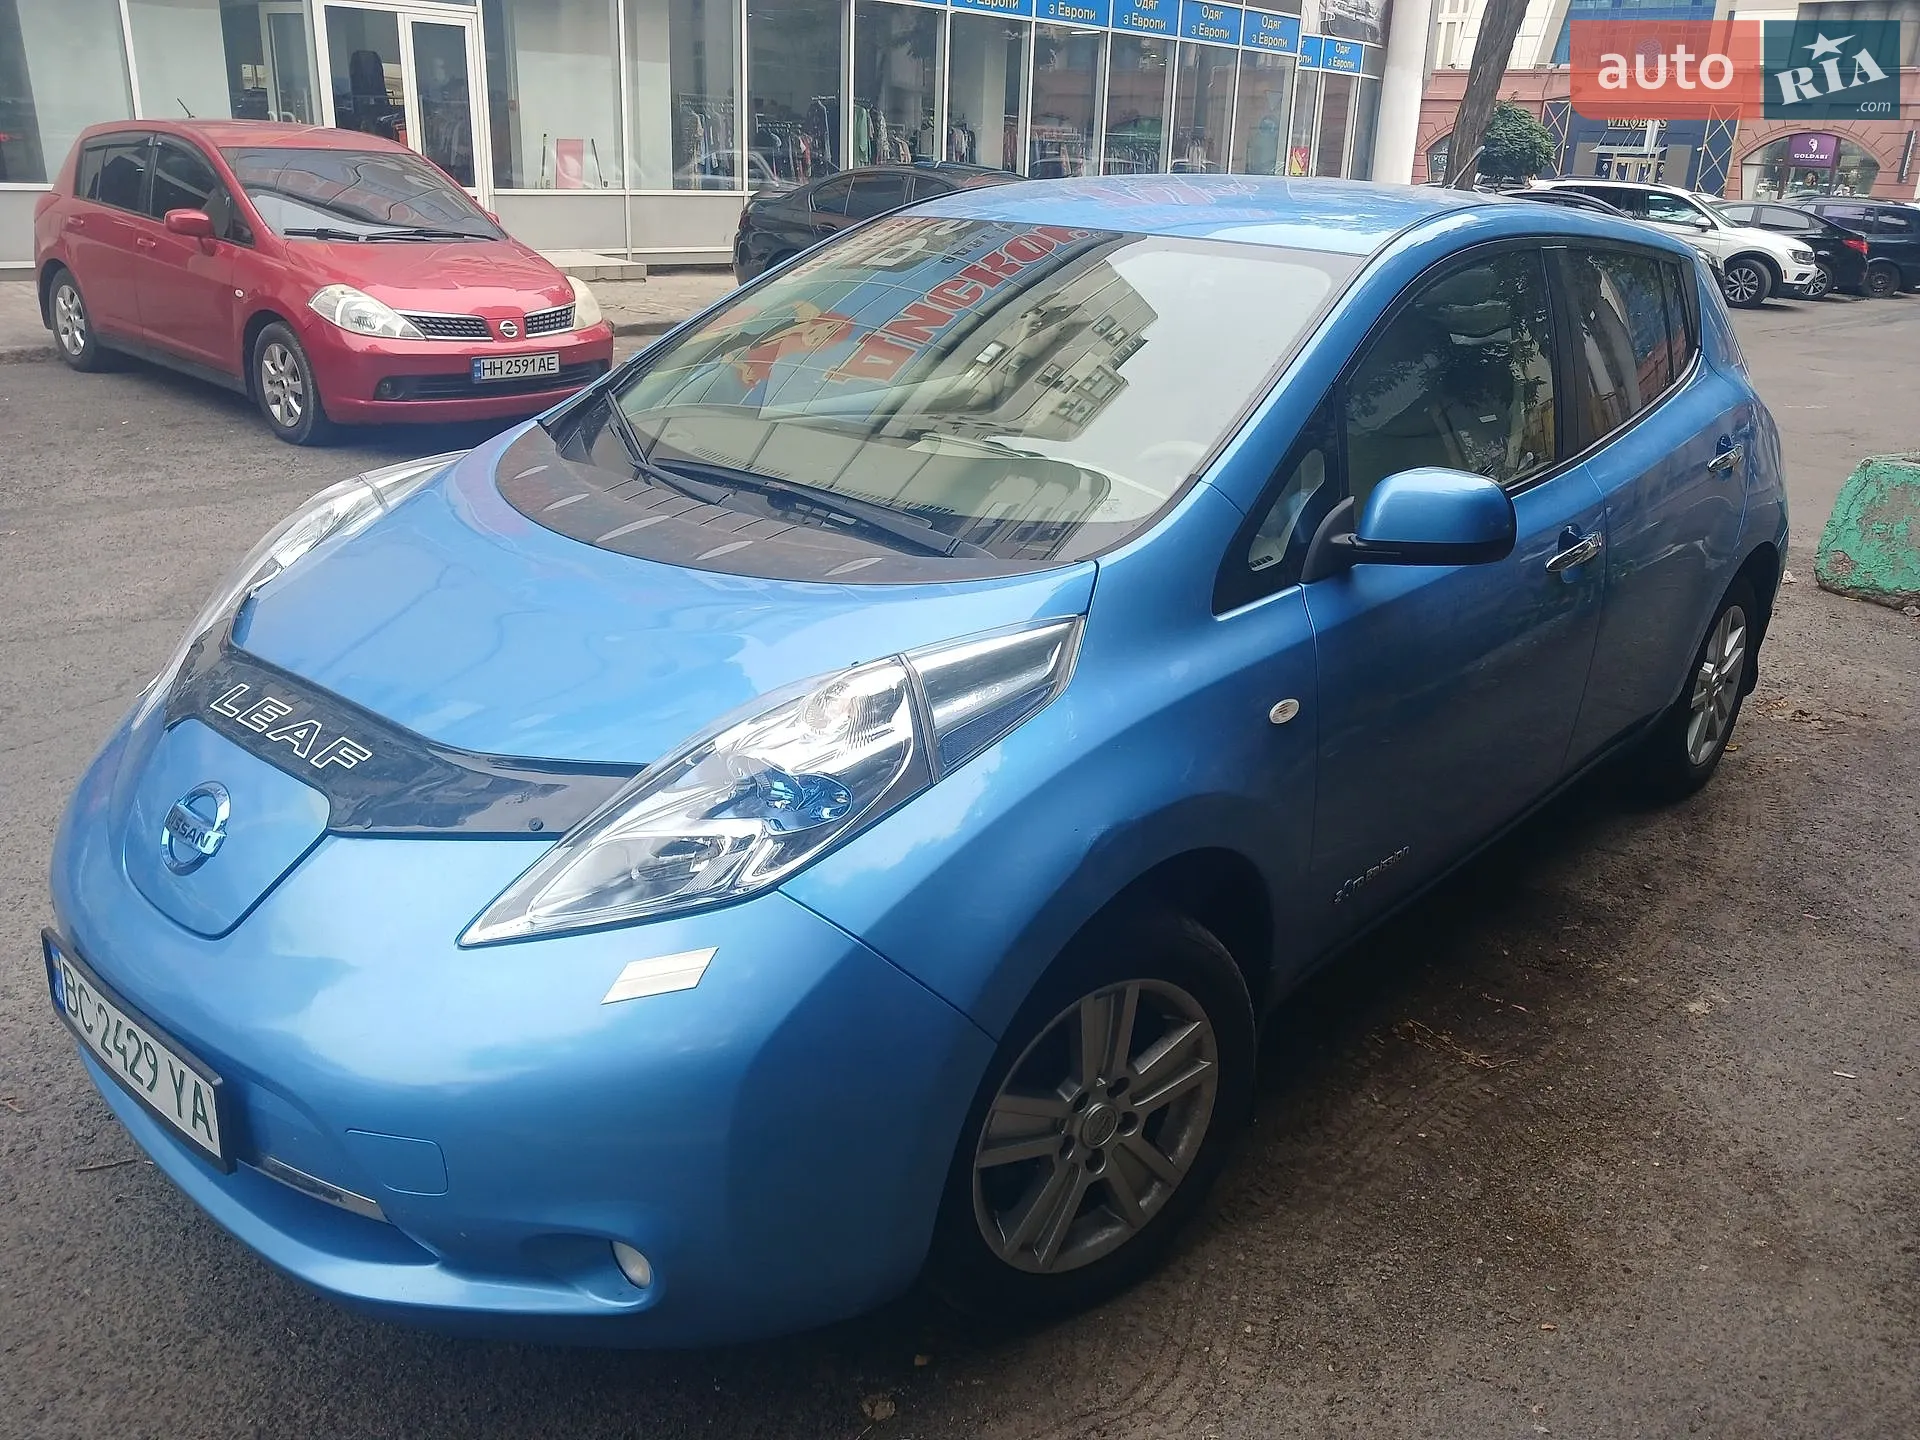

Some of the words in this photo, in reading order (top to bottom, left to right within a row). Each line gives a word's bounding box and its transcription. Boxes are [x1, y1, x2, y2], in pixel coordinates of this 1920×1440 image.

[1049, 4, 1055, 14] з
[1058, 2, 1096, 20] Европи
[1202, 5, 1224, 20] Одяг
[1123, 15, 1129, 24] з
[1132, 12, 1166, 30] Европи
[1262, 15, 1282, 30] Одяг
[1191, 25, 1197, 35] з
[1199, 23, 1230, 39] Европи
[1252, 34, 1257, 43] з
[1259, 32, 1288, 48] Европи
[482, 360, 503, 377] HH
[505, 358, 536, 375] 2591
[538, 356, 556, 372] AE
[210, 683, 373, 770] LEAF
[62, 961, 93, 1034] BC
[97, 1003, 159, 1093] 2429
[168, 1058, 214, 1144] YA
